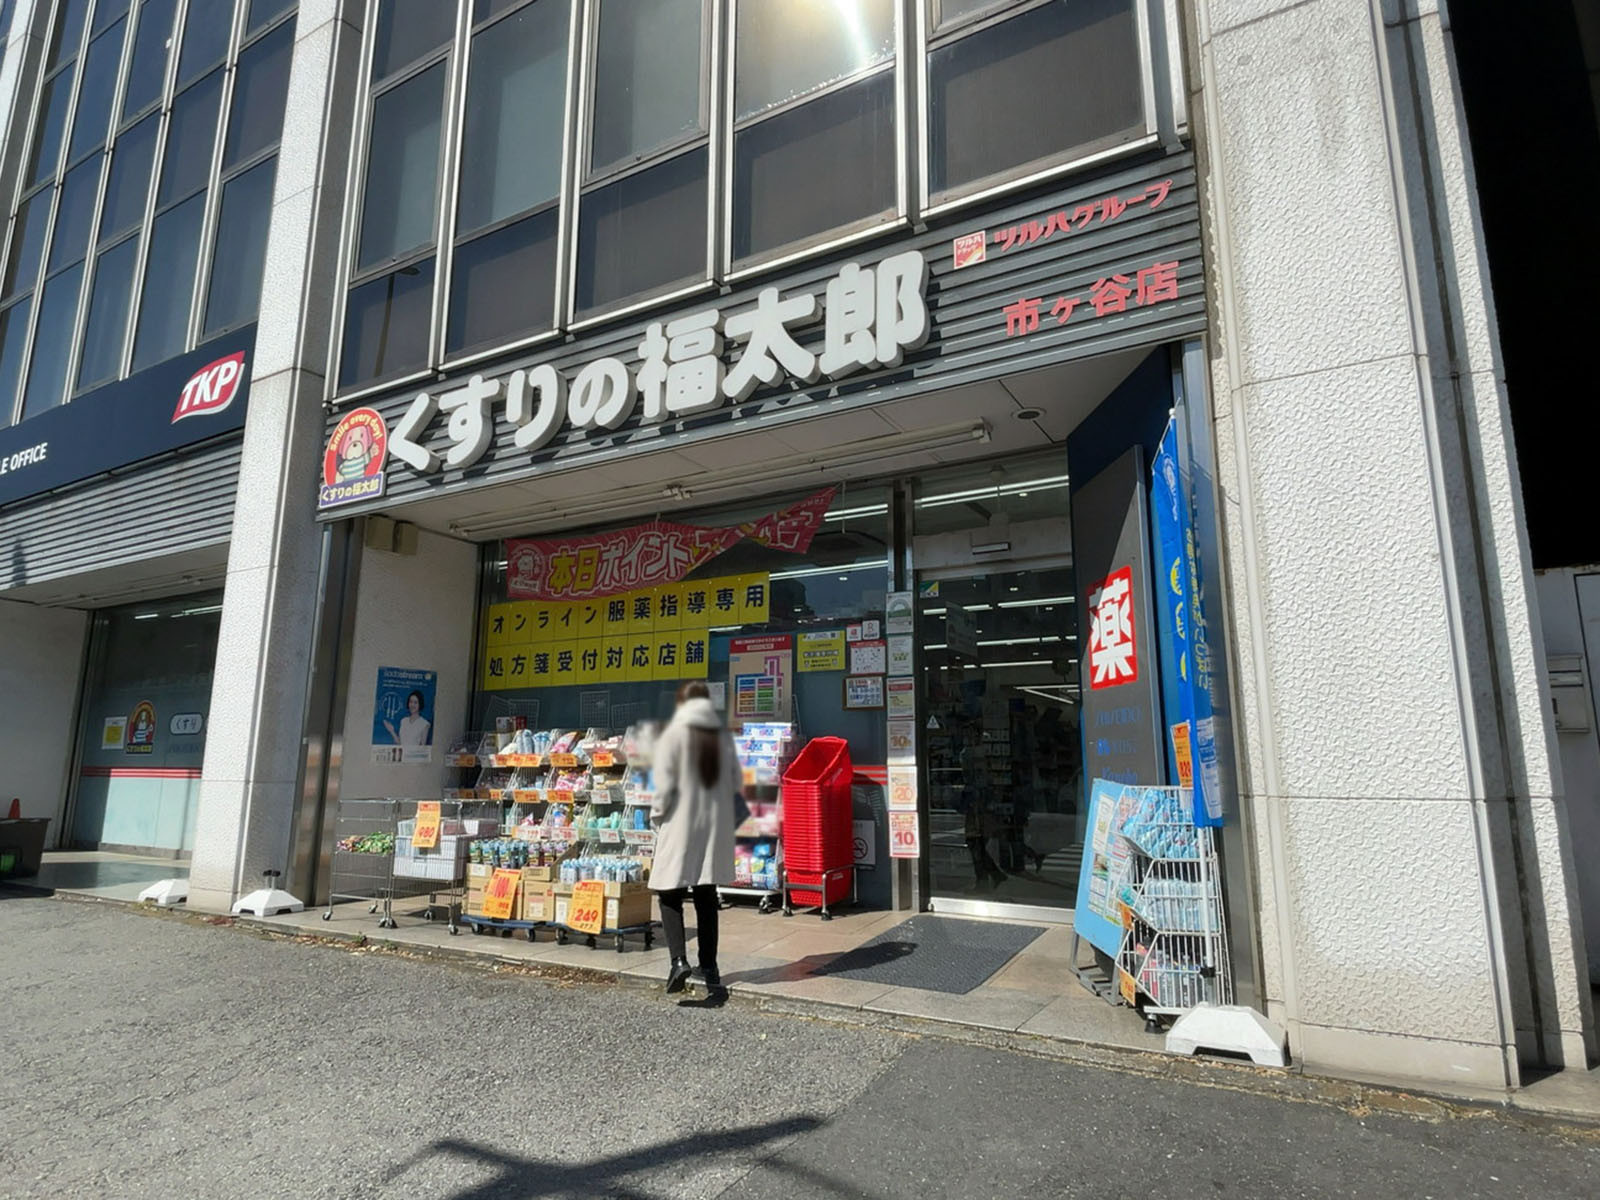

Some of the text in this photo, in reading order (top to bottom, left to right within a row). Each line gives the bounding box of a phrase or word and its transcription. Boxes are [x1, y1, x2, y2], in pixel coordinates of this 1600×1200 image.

[993, 178, 1174, 252] ツルハグループ
[179, 360, 238, 413] TKP
[388, 250, 929, 473] くすりの福太郎
[10, 442, 48, 472] OFFICE
[321, 478, 379, 502] くすりの福太郎
[492, 584, 765, 634] オンライン服薬指導専用
[1088, 578, 1136, 685] 薬
[489, 640, 705, 677] 処方箋受付対応店舗
[894, 831, 915, 846] 10
